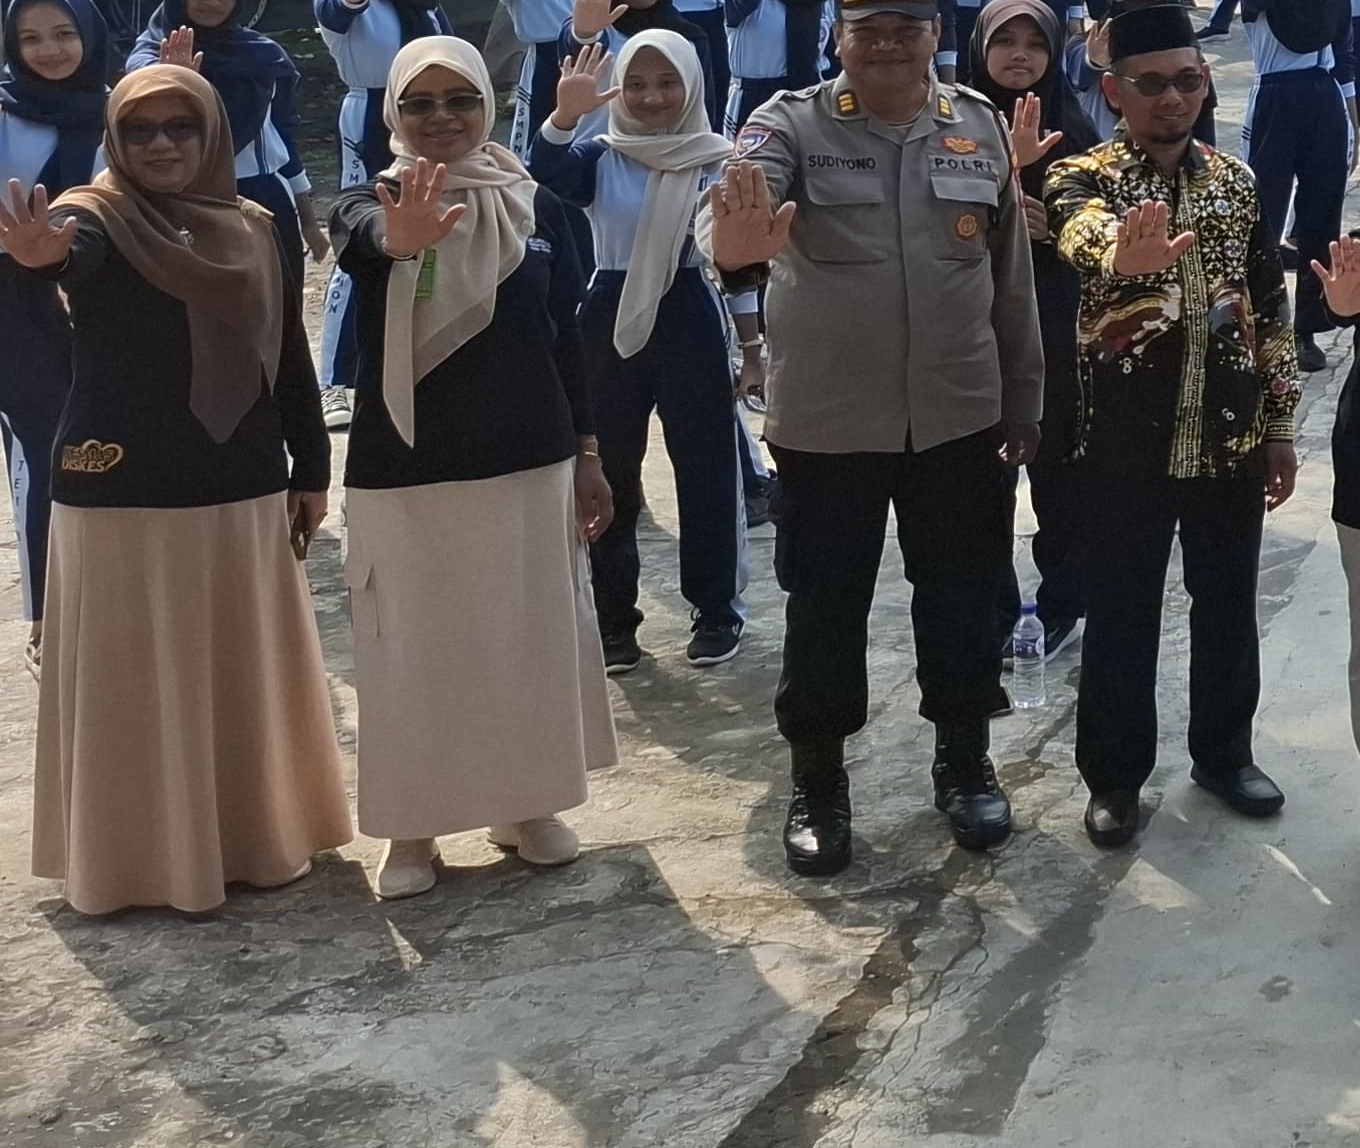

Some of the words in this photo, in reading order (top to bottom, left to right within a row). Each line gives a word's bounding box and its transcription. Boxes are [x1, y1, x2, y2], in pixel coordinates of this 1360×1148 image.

[513, 107, 525, 154] SMPN
[808, 155, 876, 170] SUDIYONO
[935, 157, 992, 172] POLRI
[349, 159, 360, 183] SM
[62, 459, 105, 473] DISKES
